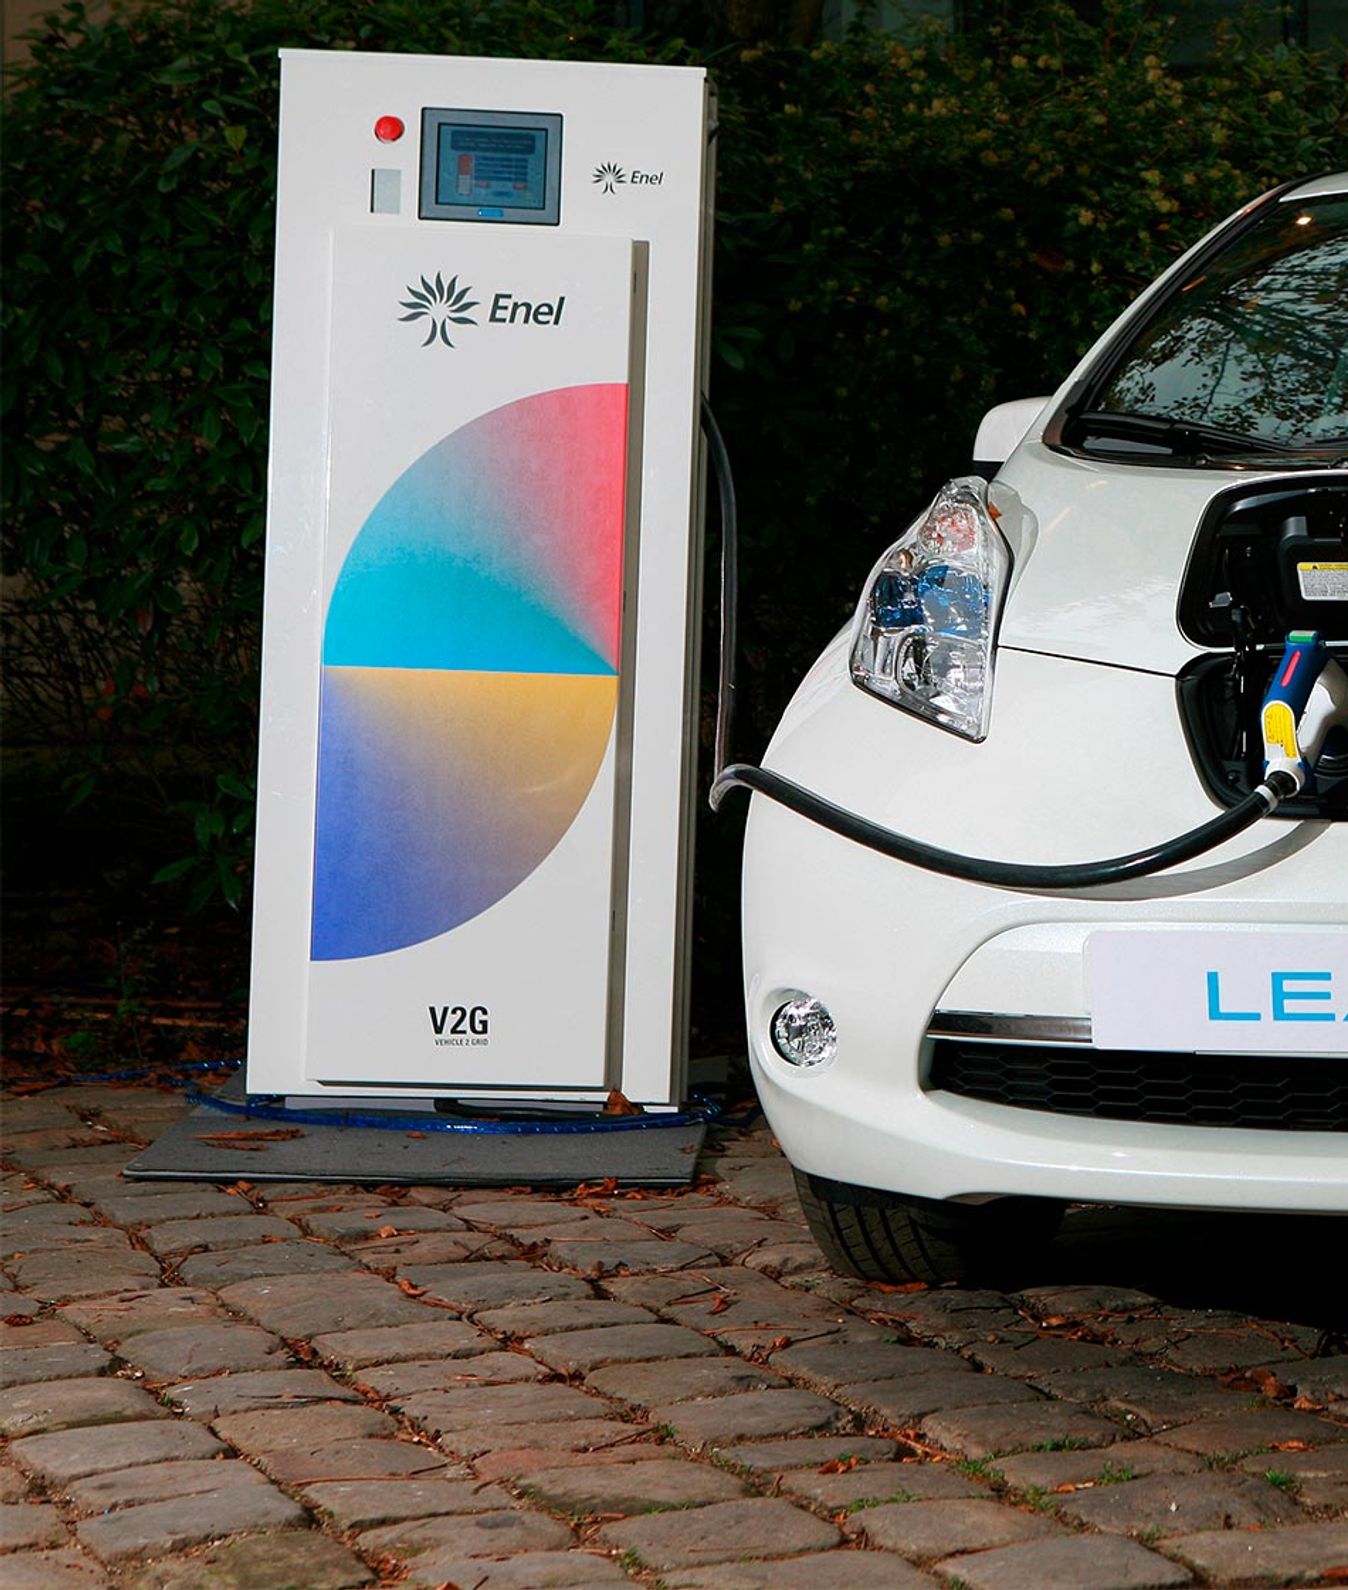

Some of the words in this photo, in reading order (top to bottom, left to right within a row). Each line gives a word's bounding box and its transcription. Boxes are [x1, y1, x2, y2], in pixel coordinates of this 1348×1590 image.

[630, 170, 664, 186] Enel
[488, 293, 565, 326] Enel
[428, 1005, 489, 1035] V2G
[434, 1038, 463, 1047] VEHICLE
[471, 1038, 489, 1047] GRID
